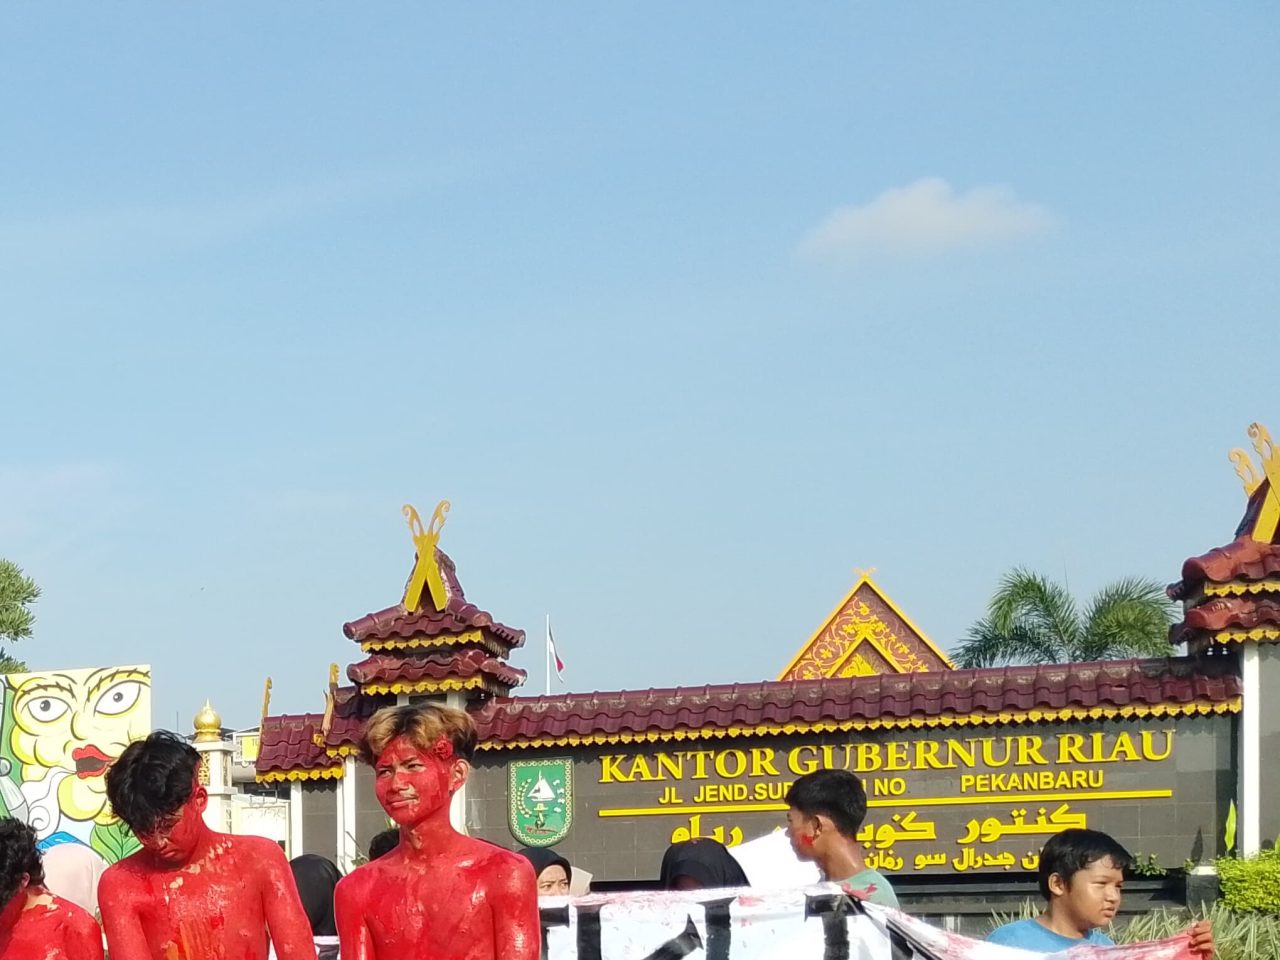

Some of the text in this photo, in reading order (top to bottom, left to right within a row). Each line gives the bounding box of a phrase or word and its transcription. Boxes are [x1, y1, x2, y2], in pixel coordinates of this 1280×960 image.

[598, 729, 1176, 784] KANTOR GUBERNUR RIAU
[659, 786, 684, 805] JL
[873, 777, 906, 796] NO
[960, 769, 1105, 793] PEKANBARU
